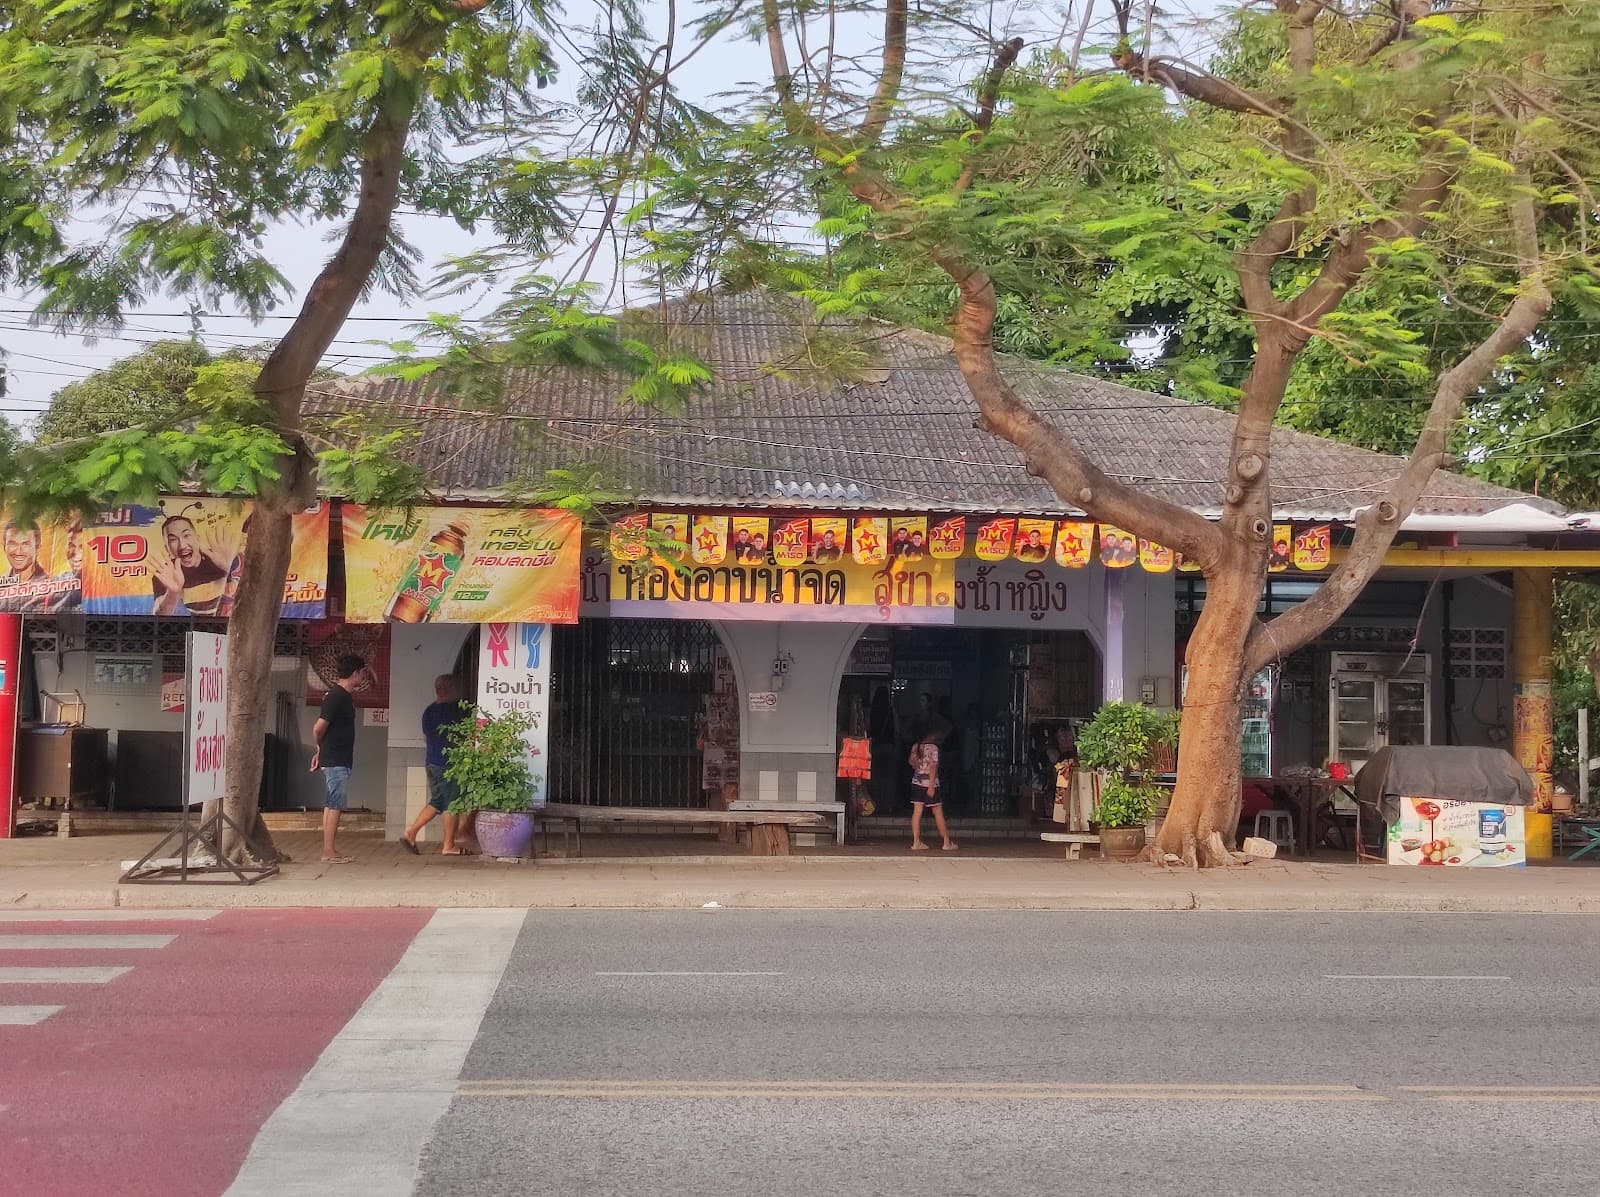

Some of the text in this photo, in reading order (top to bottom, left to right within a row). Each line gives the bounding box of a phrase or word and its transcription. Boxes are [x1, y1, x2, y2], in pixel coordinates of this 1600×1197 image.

[87, 534, 147, 564] 10
[111, 565, 147, 577] บาท
[486, 673, 542, 695] ห้องน้ำ
[496, 698, 531, 709] Toilet
